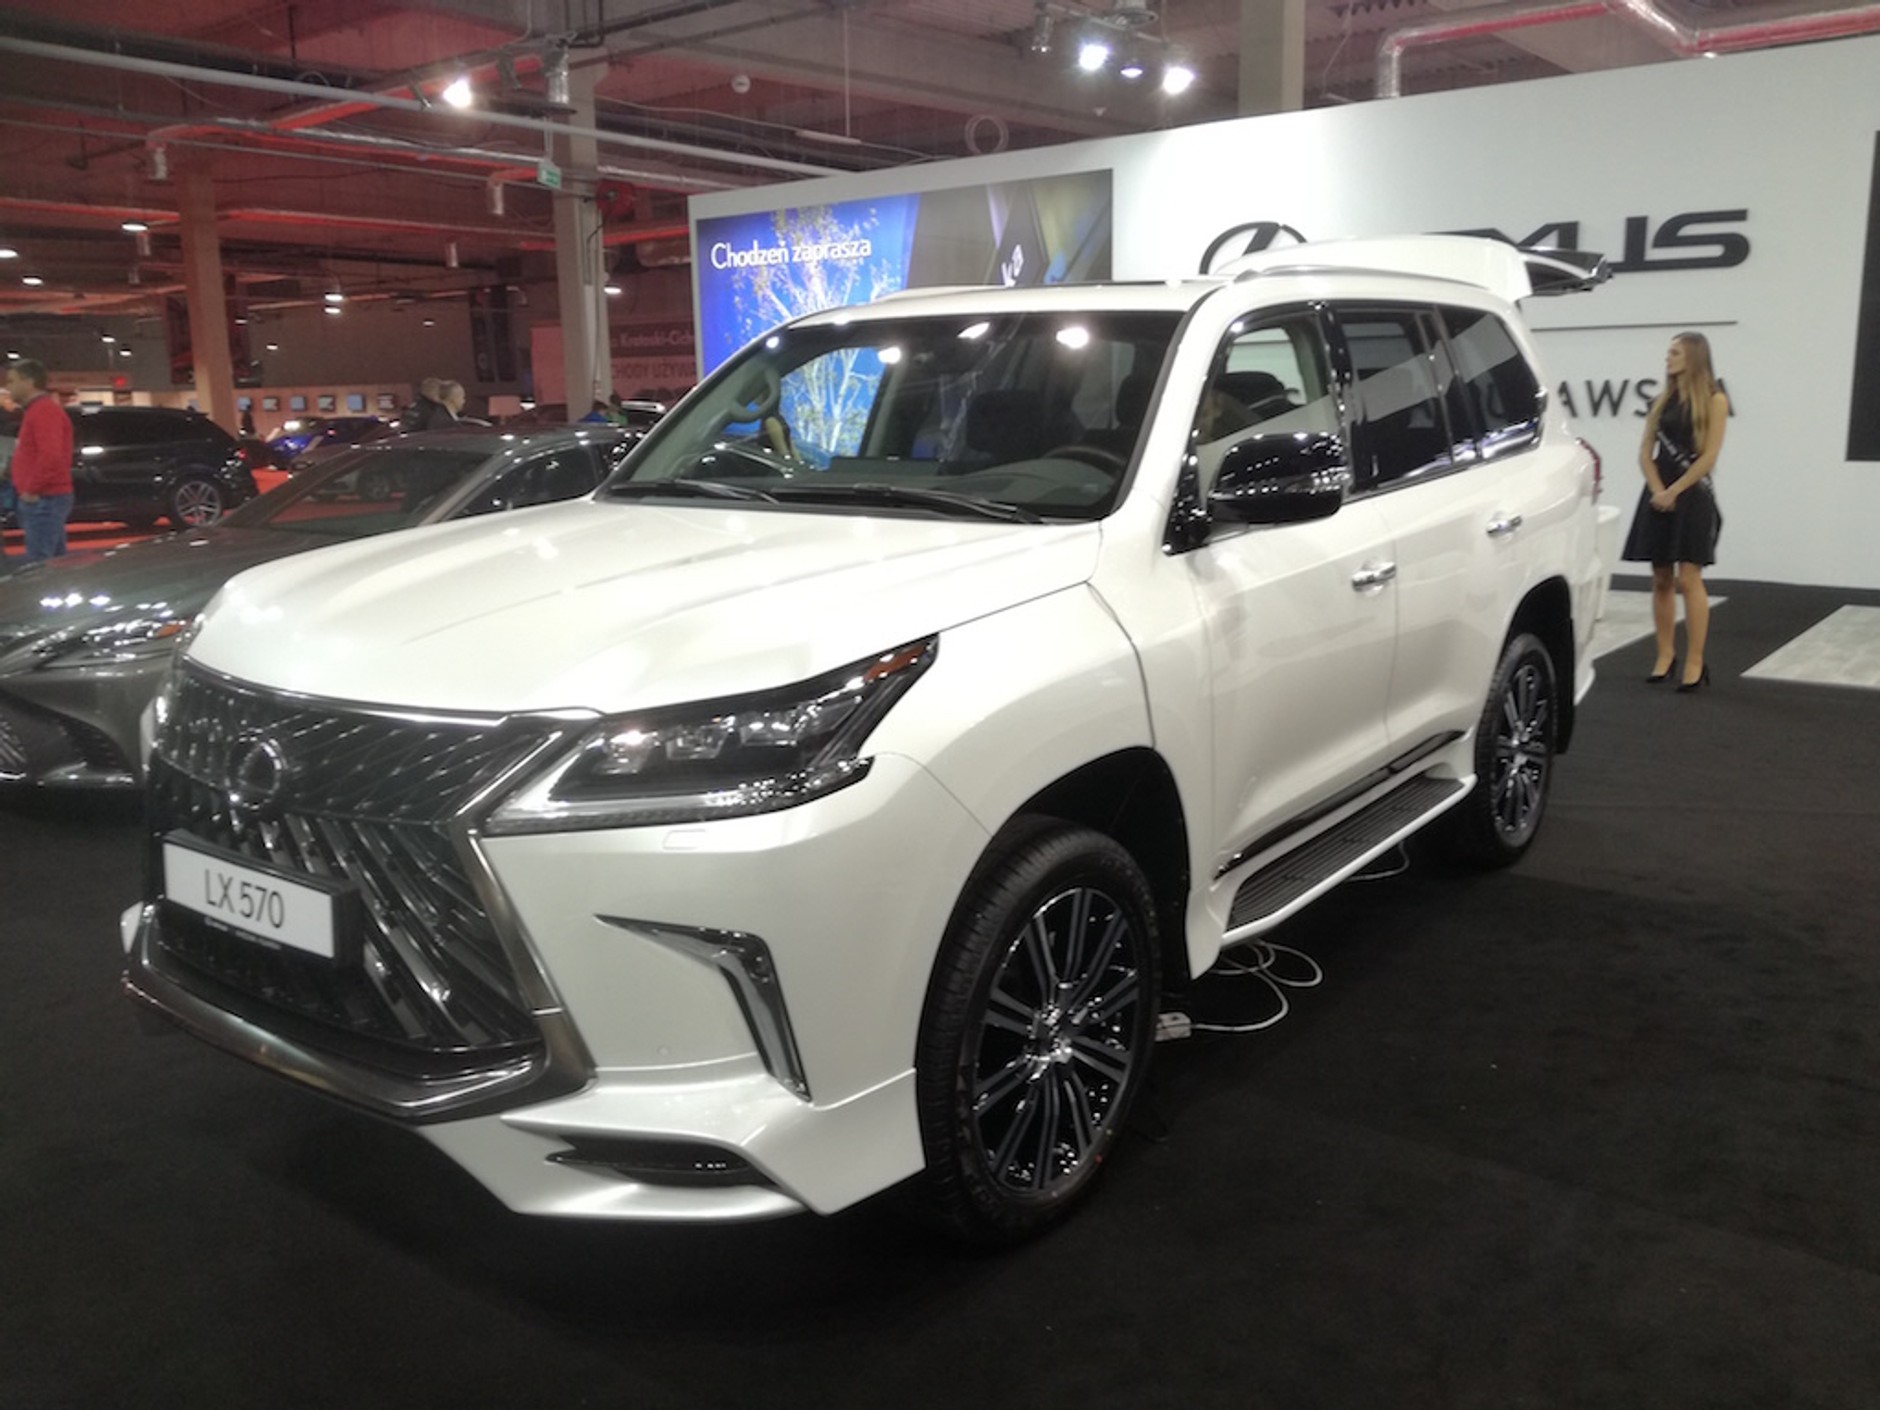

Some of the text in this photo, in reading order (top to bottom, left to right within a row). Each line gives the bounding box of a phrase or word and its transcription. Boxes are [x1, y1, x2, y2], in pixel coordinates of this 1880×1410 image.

[711, 239, 872, 269] Chodzeń zaprasza
[205, 869, 285, 929] LX 570
